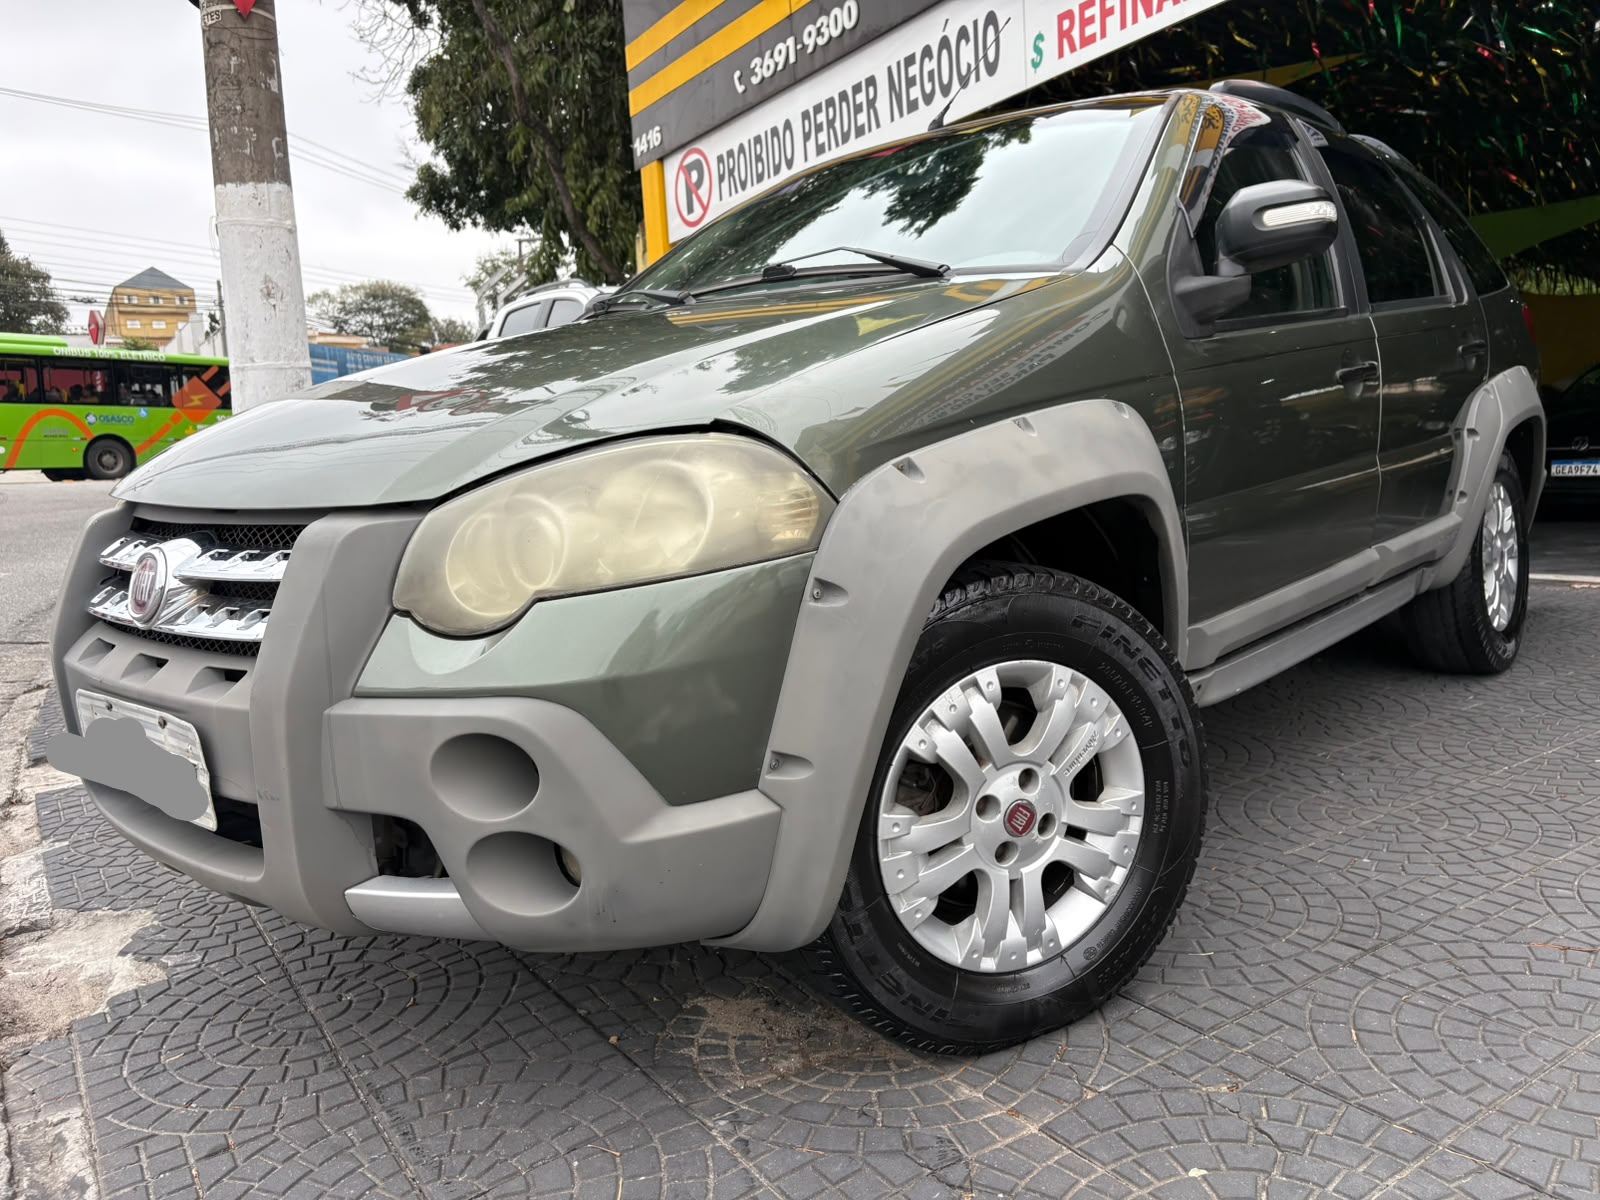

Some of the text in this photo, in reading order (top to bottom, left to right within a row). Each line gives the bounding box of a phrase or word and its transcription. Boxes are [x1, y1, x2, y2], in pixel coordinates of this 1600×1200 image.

[749, 0, 859, 85] 3691-9300
[1057, 0, 1188, 60] REFIN
[716, 118, 795, 201] PROIBIDO
[801, 74, 881, 162] PERDER
[887, 10, 1000, 123] NEGÓCIO
[633, 125, 662, 157] 1416
[98, 414, 135, 424] OSASCO
[1010, 806, 1031, 832] FIAT
